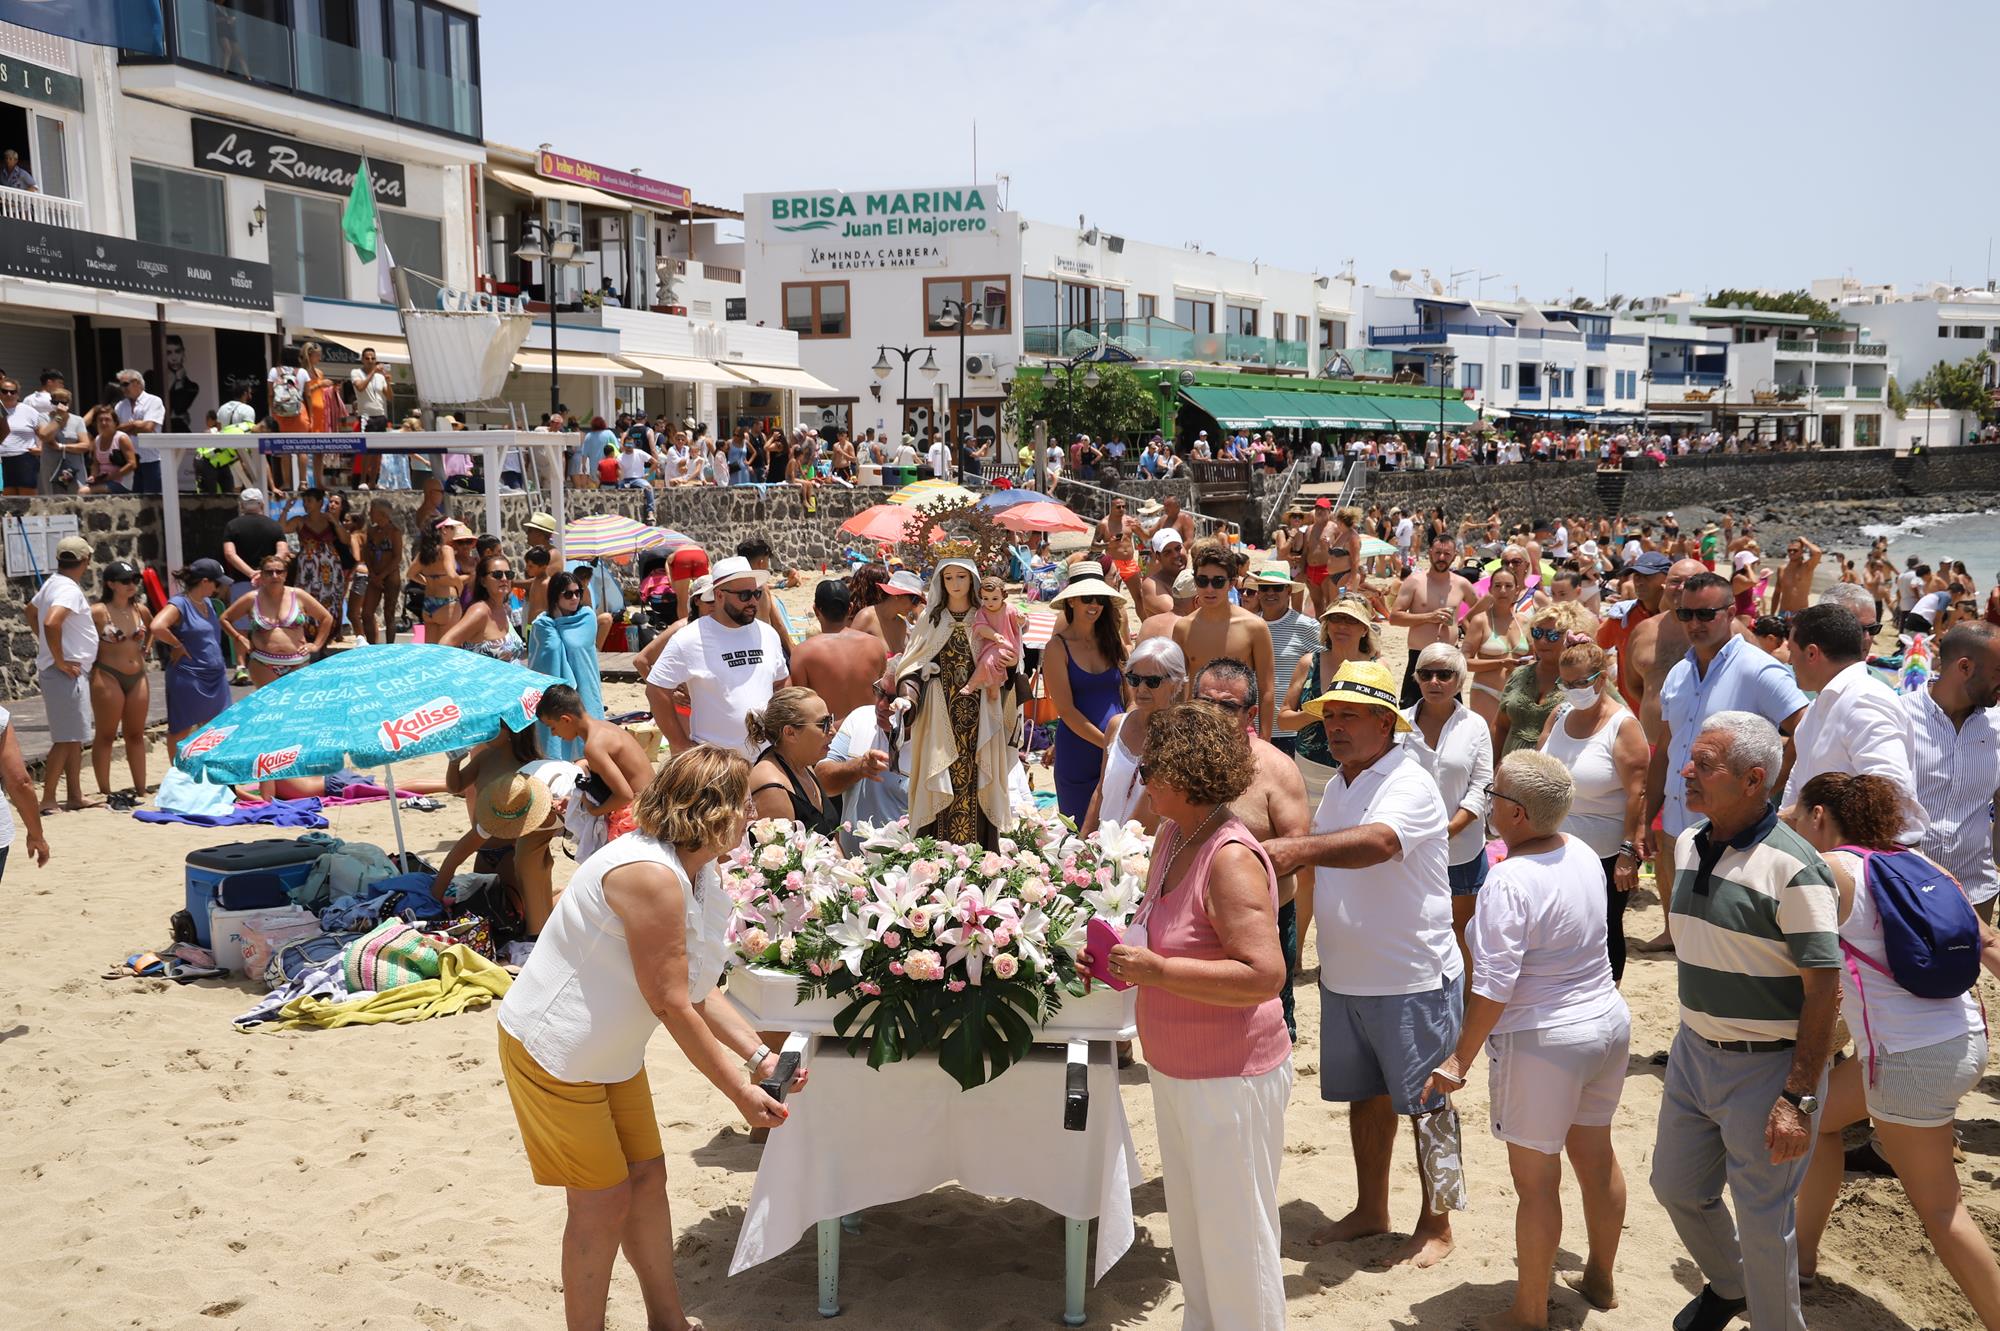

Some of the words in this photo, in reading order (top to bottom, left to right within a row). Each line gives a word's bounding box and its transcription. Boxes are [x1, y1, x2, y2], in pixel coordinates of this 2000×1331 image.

[206, 133, 255, 168] La
[268, 145, 402, 197] Romanica
[772, 196, 857, 220] BRISA
[866, 190, 986, 216] MARINA
[842, 221, 883, 238] Juan
[887, 218, 903, 235] El
[908, 217, 987, 237] Majorero
[27, 245, 63, 259] BREITLING
[878, 247, 939, 258] CABRERA
[136, 259, 169, 273] LONGINES
[832, 259, 875, 270] BEAUTY
[880, 260, 885, 268] &
[891, 258, 916, 267] HAIR
[187, 266, 212, 280] RADO
[230, 276, 253, 290] TISSOT
[1355, 685, 1371, 694] RON
[383, 704, 459, 750] Kalise
[257, 750, 298, 778] Kalise
